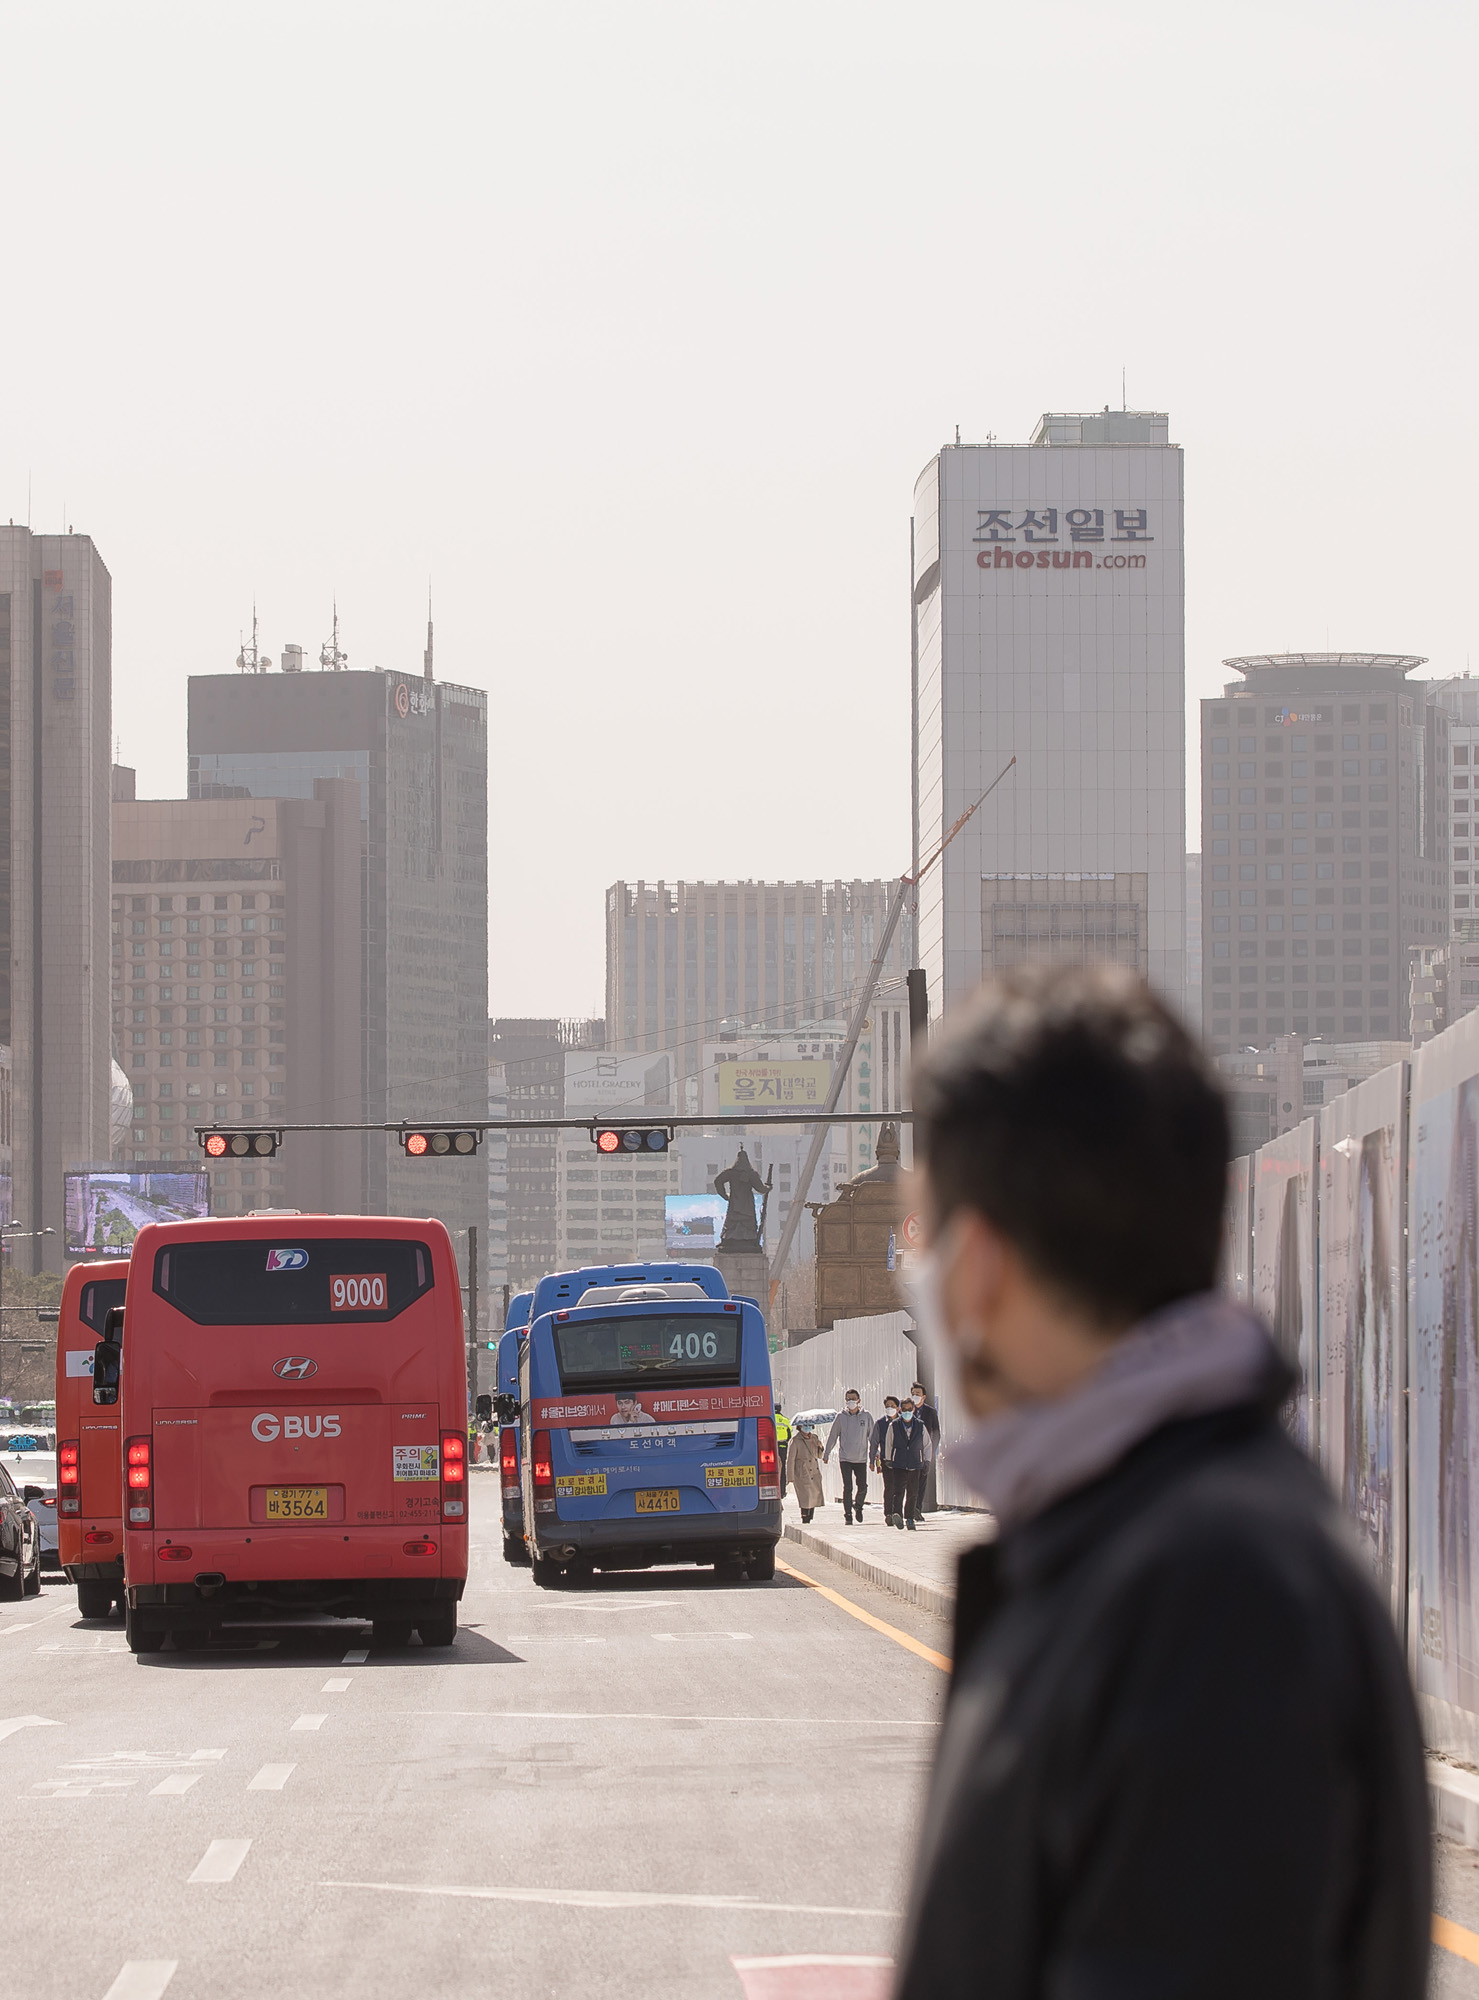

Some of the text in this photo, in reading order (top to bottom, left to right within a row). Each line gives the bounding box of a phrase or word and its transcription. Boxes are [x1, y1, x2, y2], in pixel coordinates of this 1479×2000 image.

[972, 507, 1154, 542] 조선일보
[976, 545, 1146, 569] chosun.com
[732, 1078, 782, 1100] 을지
[333, 1278, 384, 1307] 9000
[669, 1331, 717, 1359] 406
[541, 1404, 607, 1419] #올리브영에서
[395, 1448, 420, 1461] 주의
[700, 1460, 734, 1468] Automatic
[707, 1477, 755, 1487] 양보 감사합니다
[281, 1490, 312, 1499] 경기 77
[557, 1484, 605, 1496] 양보 감사합니다
[269, 1500, 325, 1516] 바 3564
[405, 1497, 440, 1508] 경기고속
[638, 1497, 678, 1511] 사 4410
